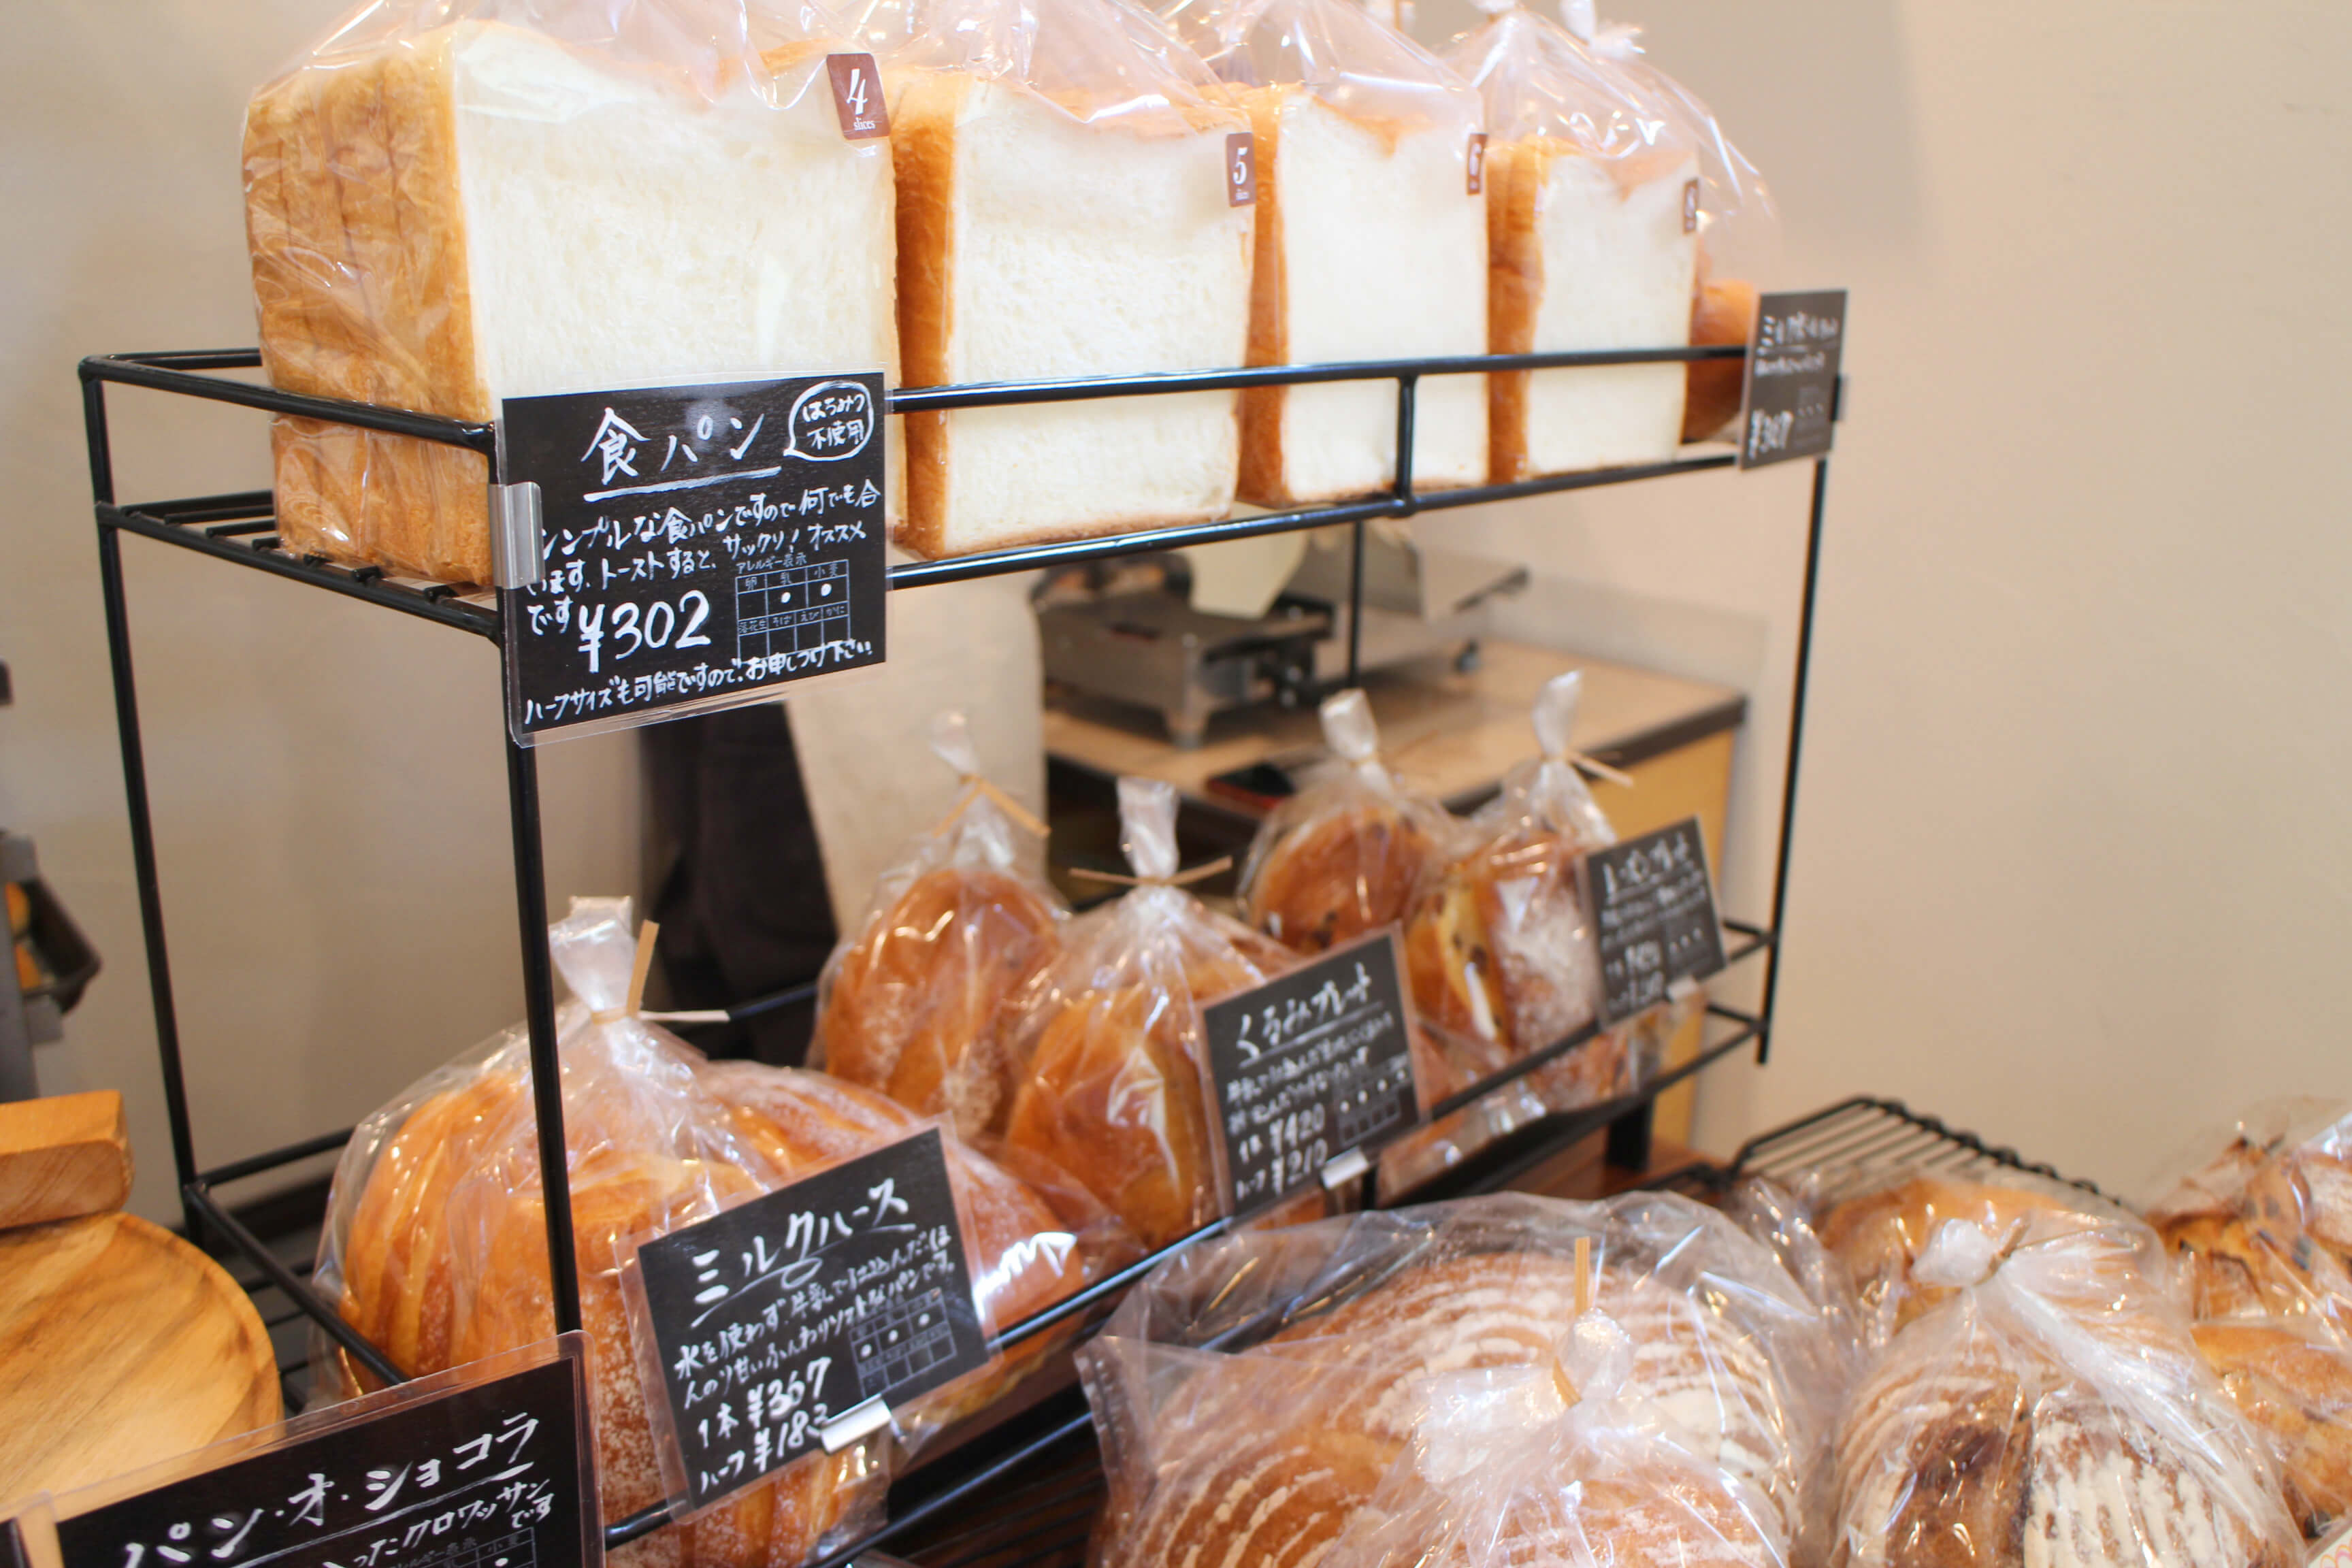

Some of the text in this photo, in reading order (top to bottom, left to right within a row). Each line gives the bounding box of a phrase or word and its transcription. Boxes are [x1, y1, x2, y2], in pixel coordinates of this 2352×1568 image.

[846, 68, 868, 116] 4
[1232, 146, 1247, 185] 5
[581, 408, 764, 485] 食パン
[806, 419, 864, 450] 不使用
[736, 552, 807, 574] アレルギー表示
[814, 564, 839, 578] 小麦
[527, 595, 574, 635] です
[578, 589, 711, 673] ¥302
[693, 1177, 909, 1304] ミルクハース
[698, 1357, 832, 1448] 1本 ¥367
[700, 1450, 746, 1494] ハーフ
[512, 1494, 554, 1529] です
